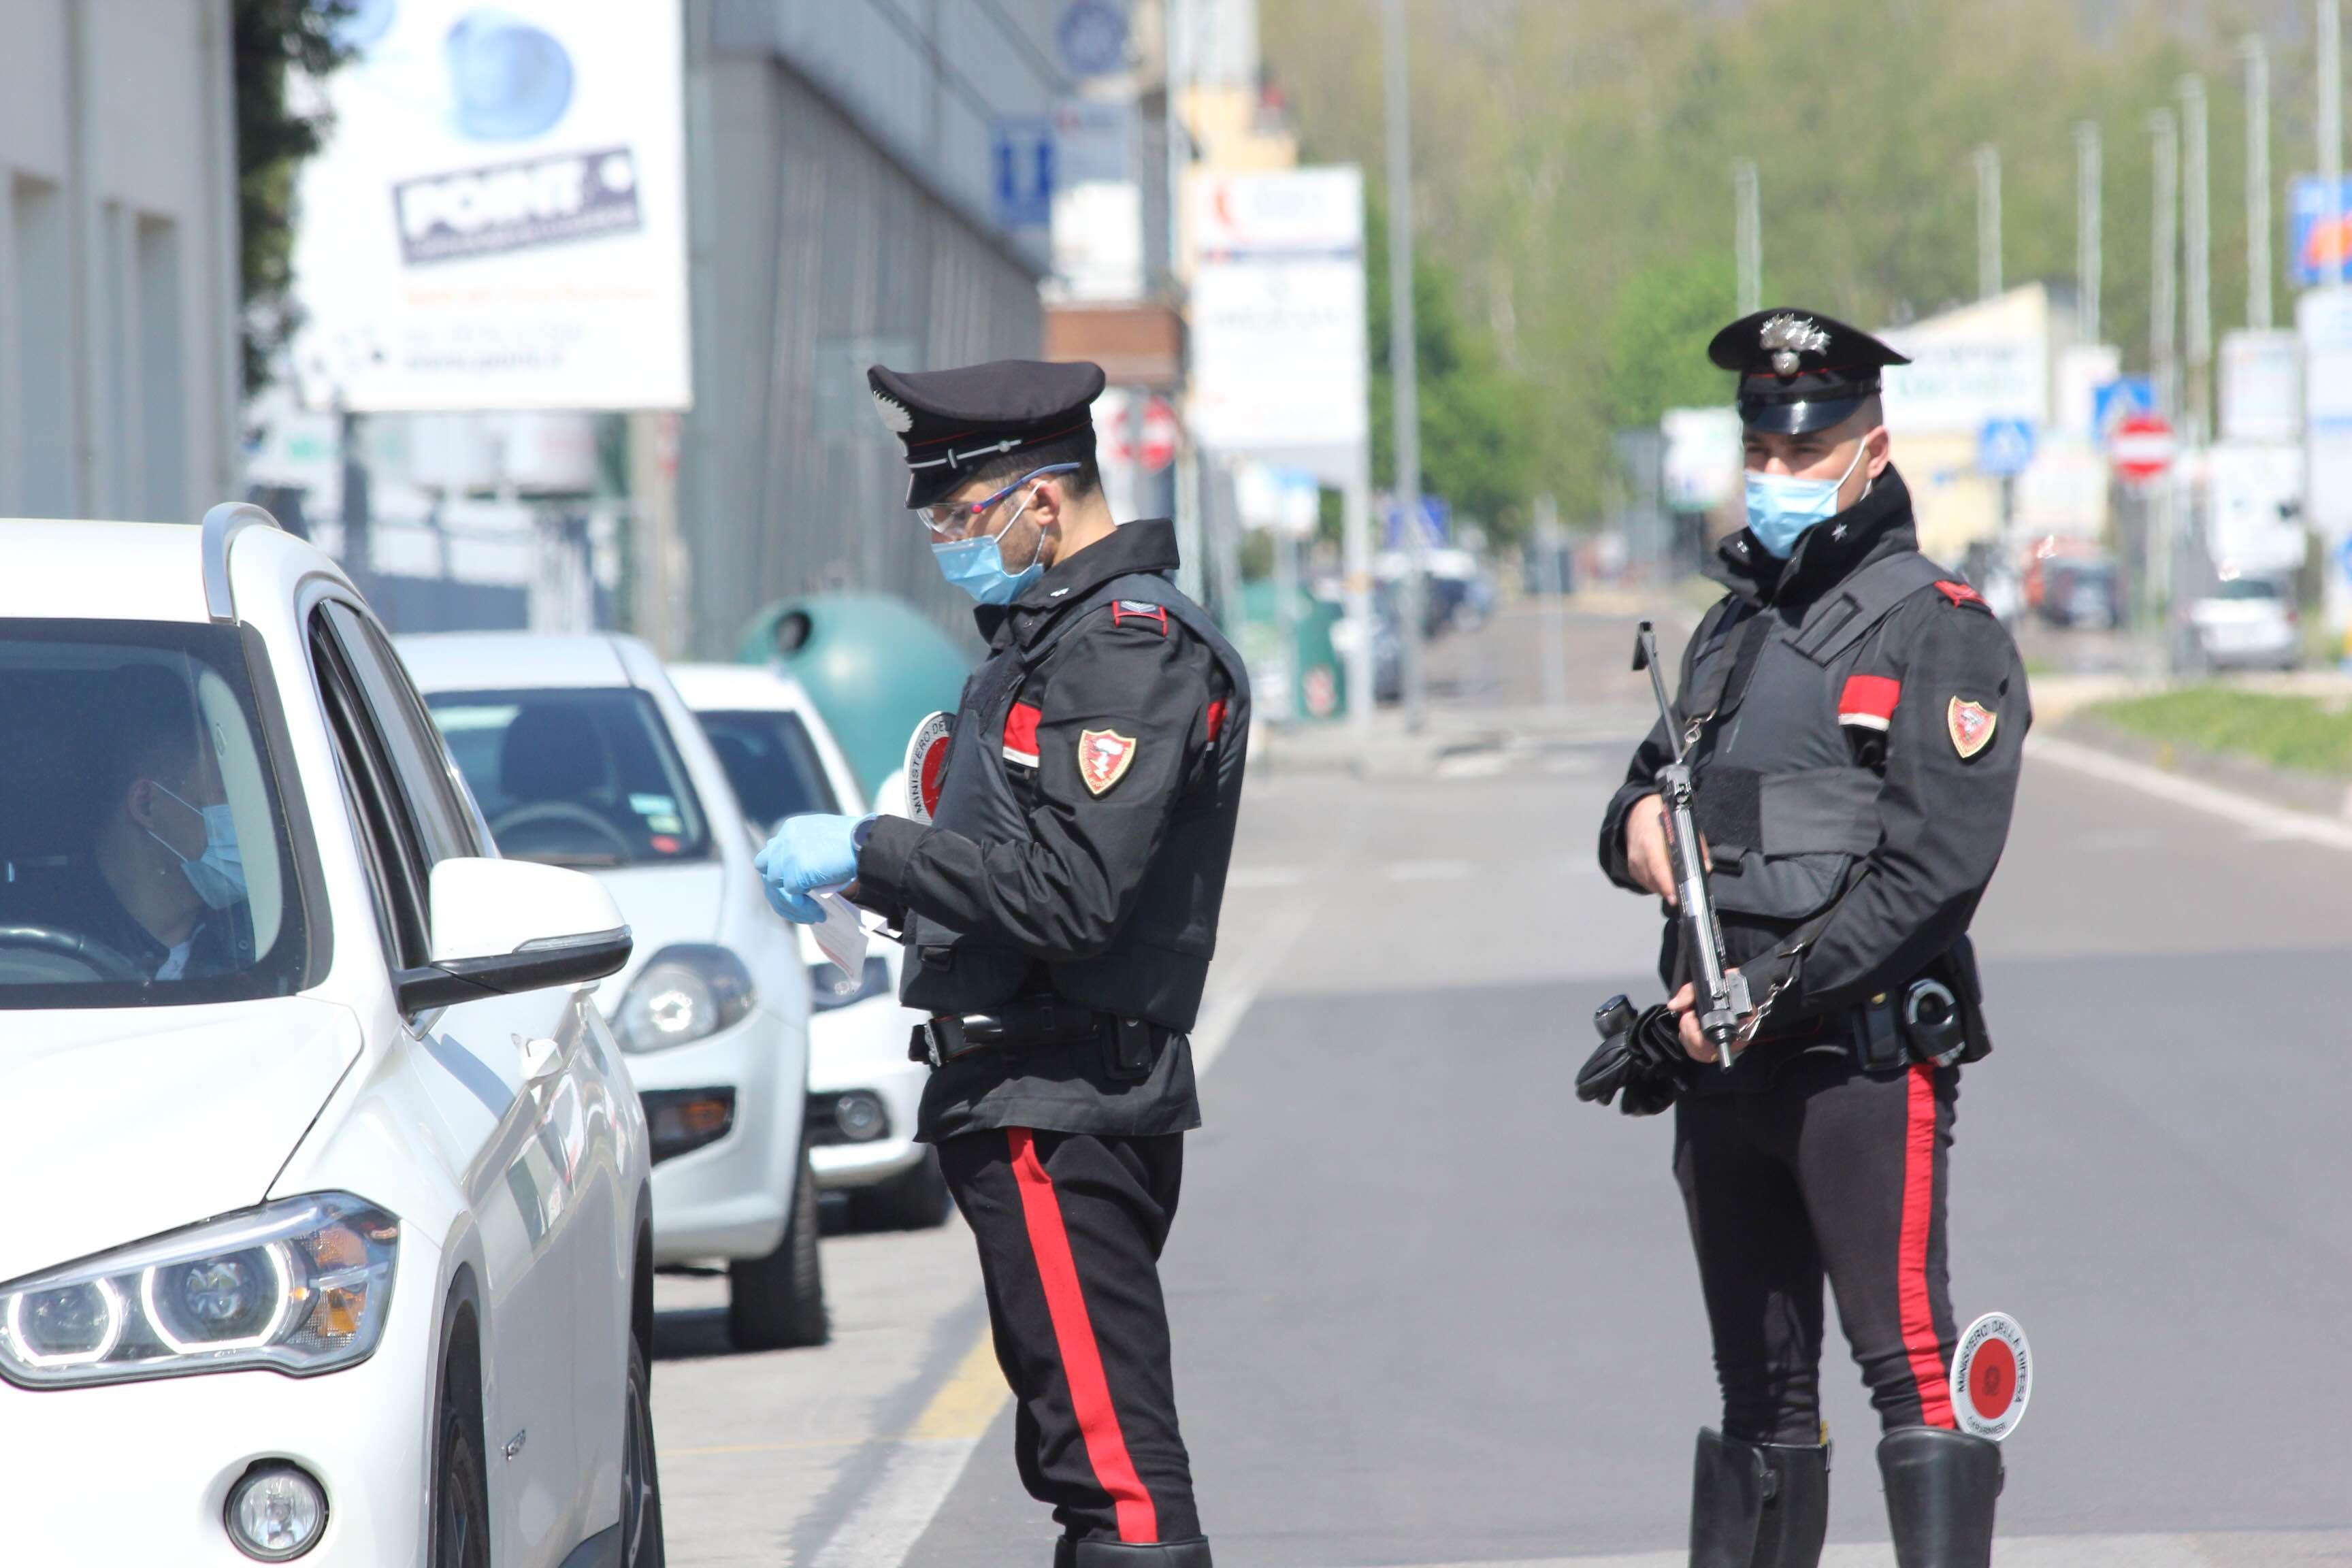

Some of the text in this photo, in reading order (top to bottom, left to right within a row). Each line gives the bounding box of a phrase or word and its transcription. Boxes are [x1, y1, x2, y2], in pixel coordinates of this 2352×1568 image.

[911, 731, 930, 814] MINISTERO
[1957, 1324, 1988, 1393] MINISTERO
[2014, 1350, 2026, 1403] DIFESA
